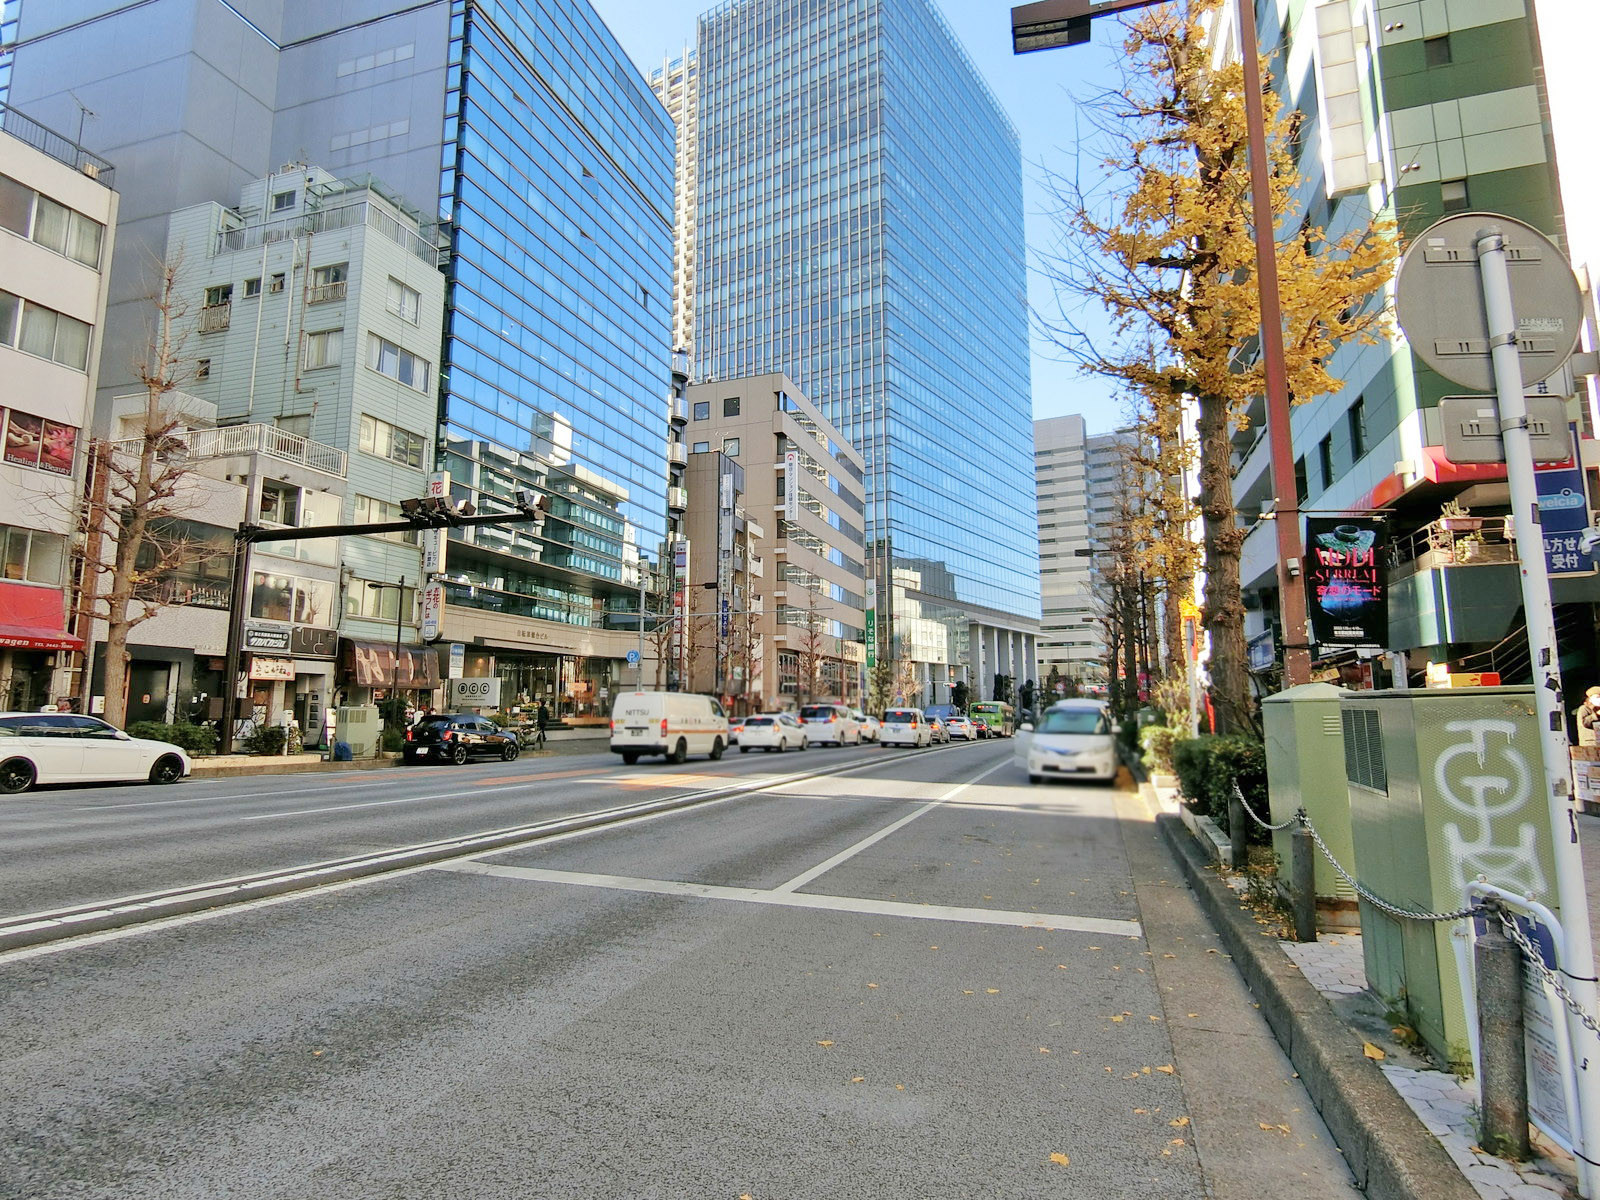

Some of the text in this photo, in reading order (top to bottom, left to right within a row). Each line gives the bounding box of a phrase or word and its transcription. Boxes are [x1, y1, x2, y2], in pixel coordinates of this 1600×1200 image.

[7, 453, 38, 467] Healing
[45, 462, 71, 475] Beauty
[431, 481, 443, 495] 花
[1538, 495, 1579, 508] welcia
[1552, 554, 1579, 569] 受付
[424, 589, 432, 619] ギフトは
[432, 587, 440, 609] お花の
[867, 620, 875, 658] りそな銀行
